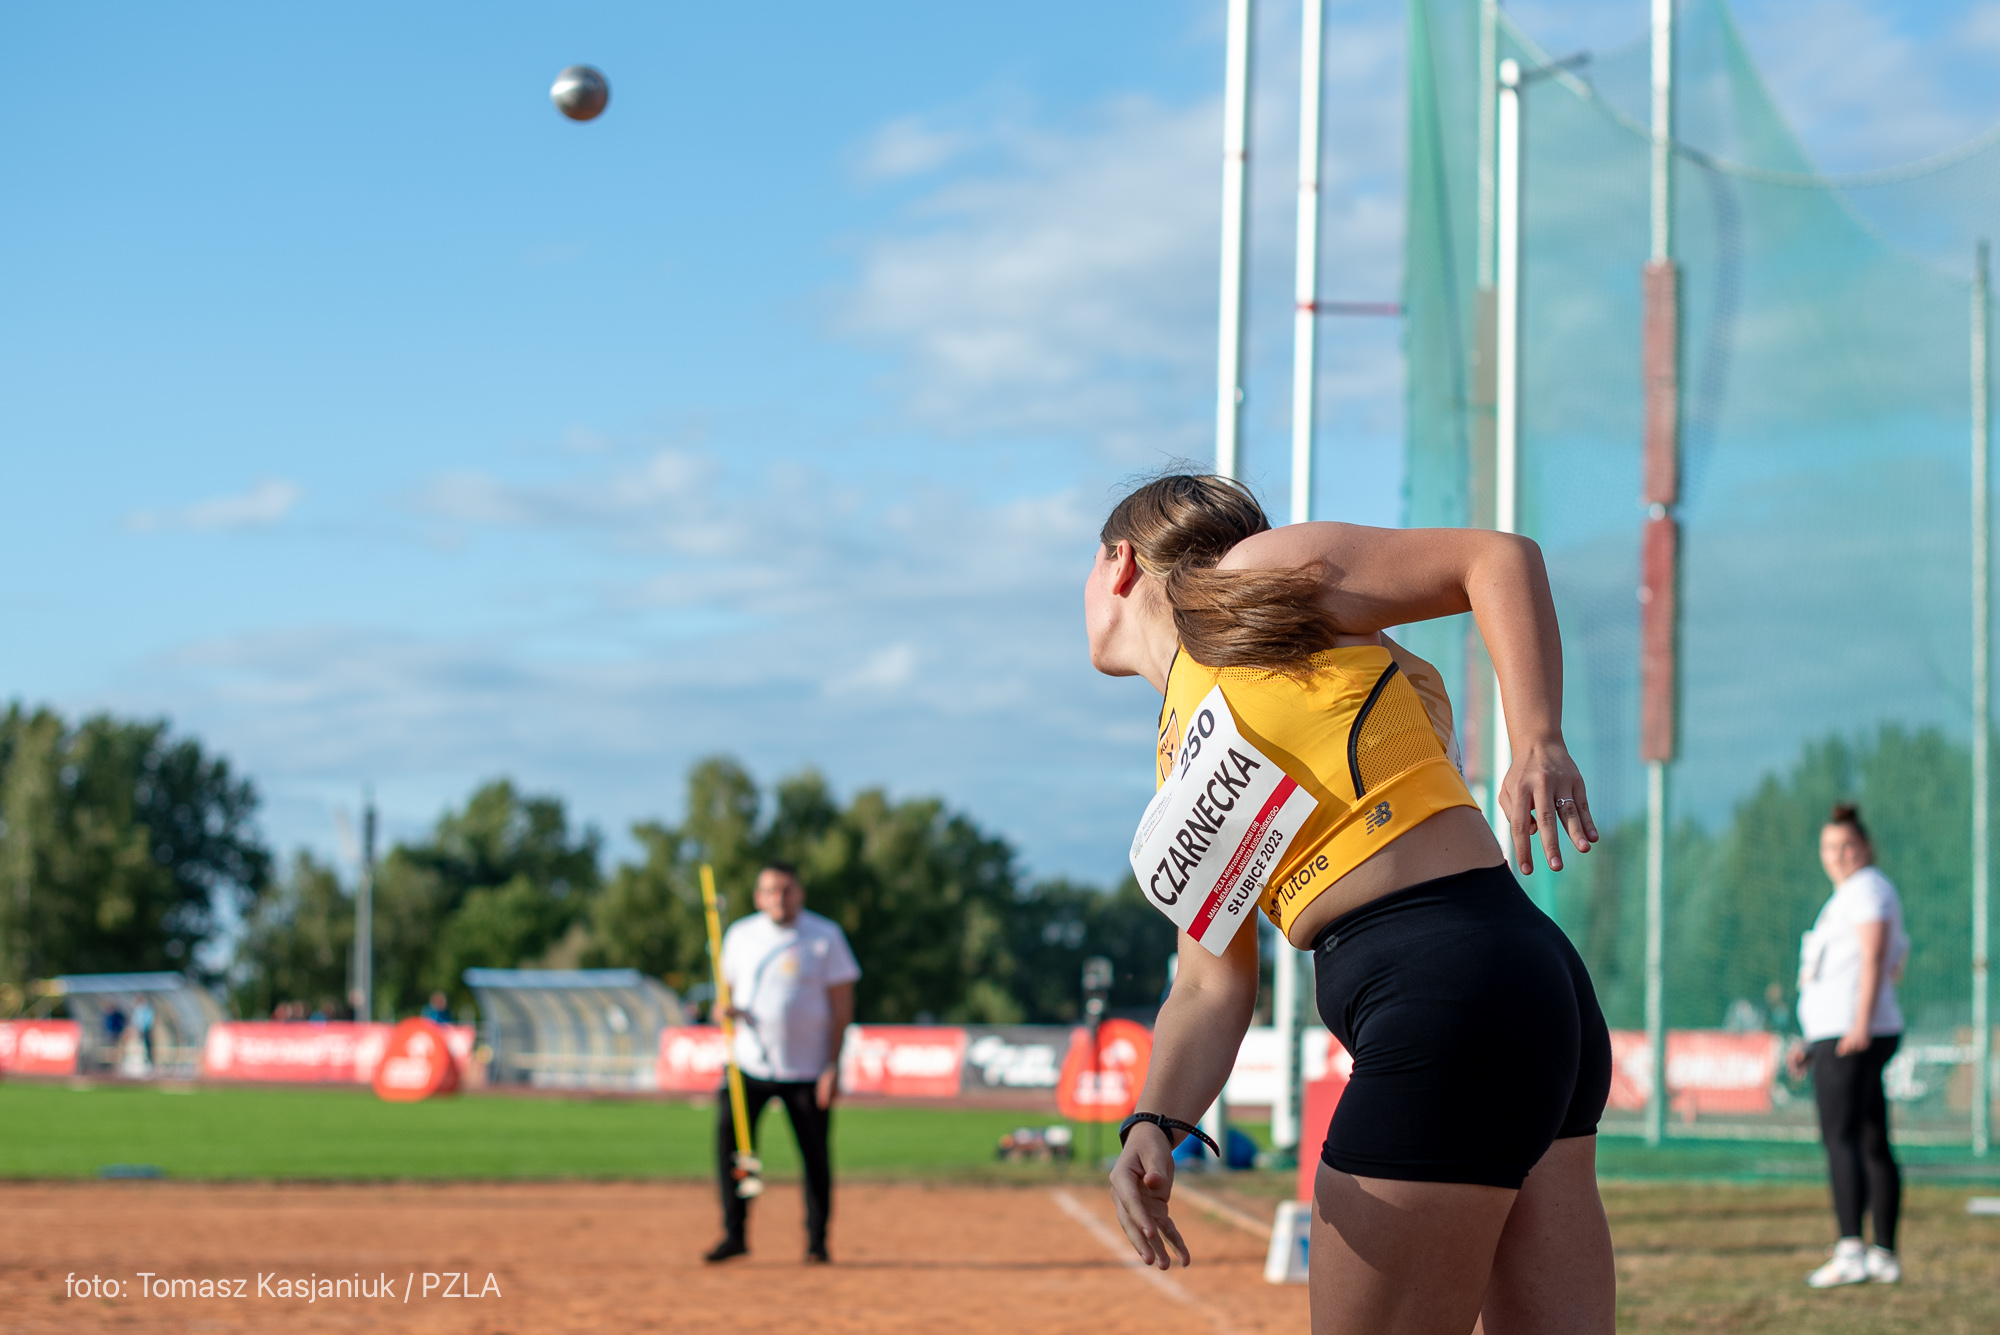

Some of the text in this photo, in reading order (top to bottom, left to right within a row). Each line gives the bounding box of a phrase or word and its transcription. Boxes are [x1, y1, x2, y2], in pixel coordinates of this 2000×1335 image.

[1181, 709, 1214, 780] 250
[1150, 748, 1261, 905] CZARNECKA
[1236, 848, 1253, 874] JANUSZA
[1251, 805, 1279, 850] KUSOCIŃSKIEGO
[1213, 879, 1226, 894] PZLA
[1223, 846, 1243, 880] Mistrzostwa
[1241, 830, 1257, 850] Polski
[1227, 829, 1284, 916] SŁUBICE 2023
[1275, 854, 1329, 907] Tutore
